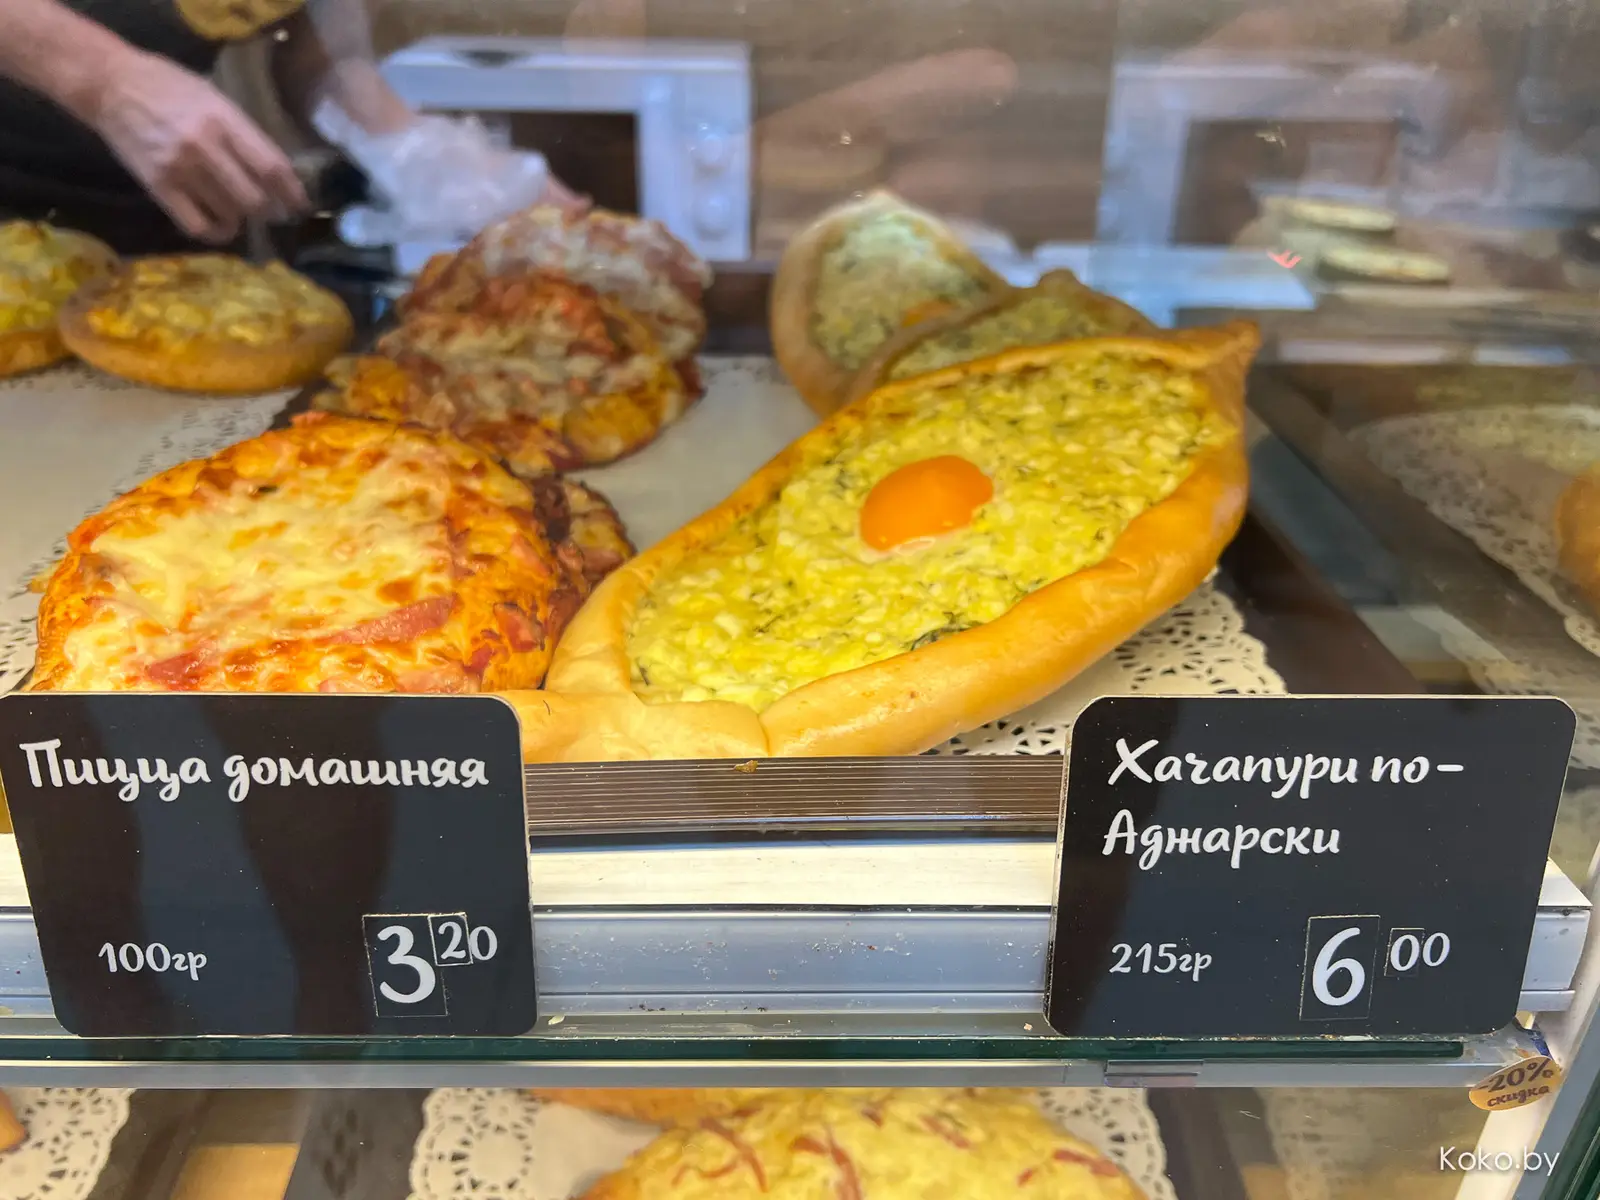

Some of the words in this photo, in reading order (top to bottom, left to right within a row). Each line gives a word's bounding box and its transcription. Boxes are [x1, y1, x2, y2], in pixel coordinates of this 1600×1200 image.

[19, 738, 212, 802] Пицца
[223, 754, 490, 803] домашняя
[1107, 738, 1358, 800] Хачапури
[1102, 809, 1340, 871] Аджарски
[98, 942, 207, 981] 100гр
[1109, 942, 1212, 982] 215гр
[1478, 1058, 1554, 1093] -20%
[1487, 1085, 1550, 1107] скидка
